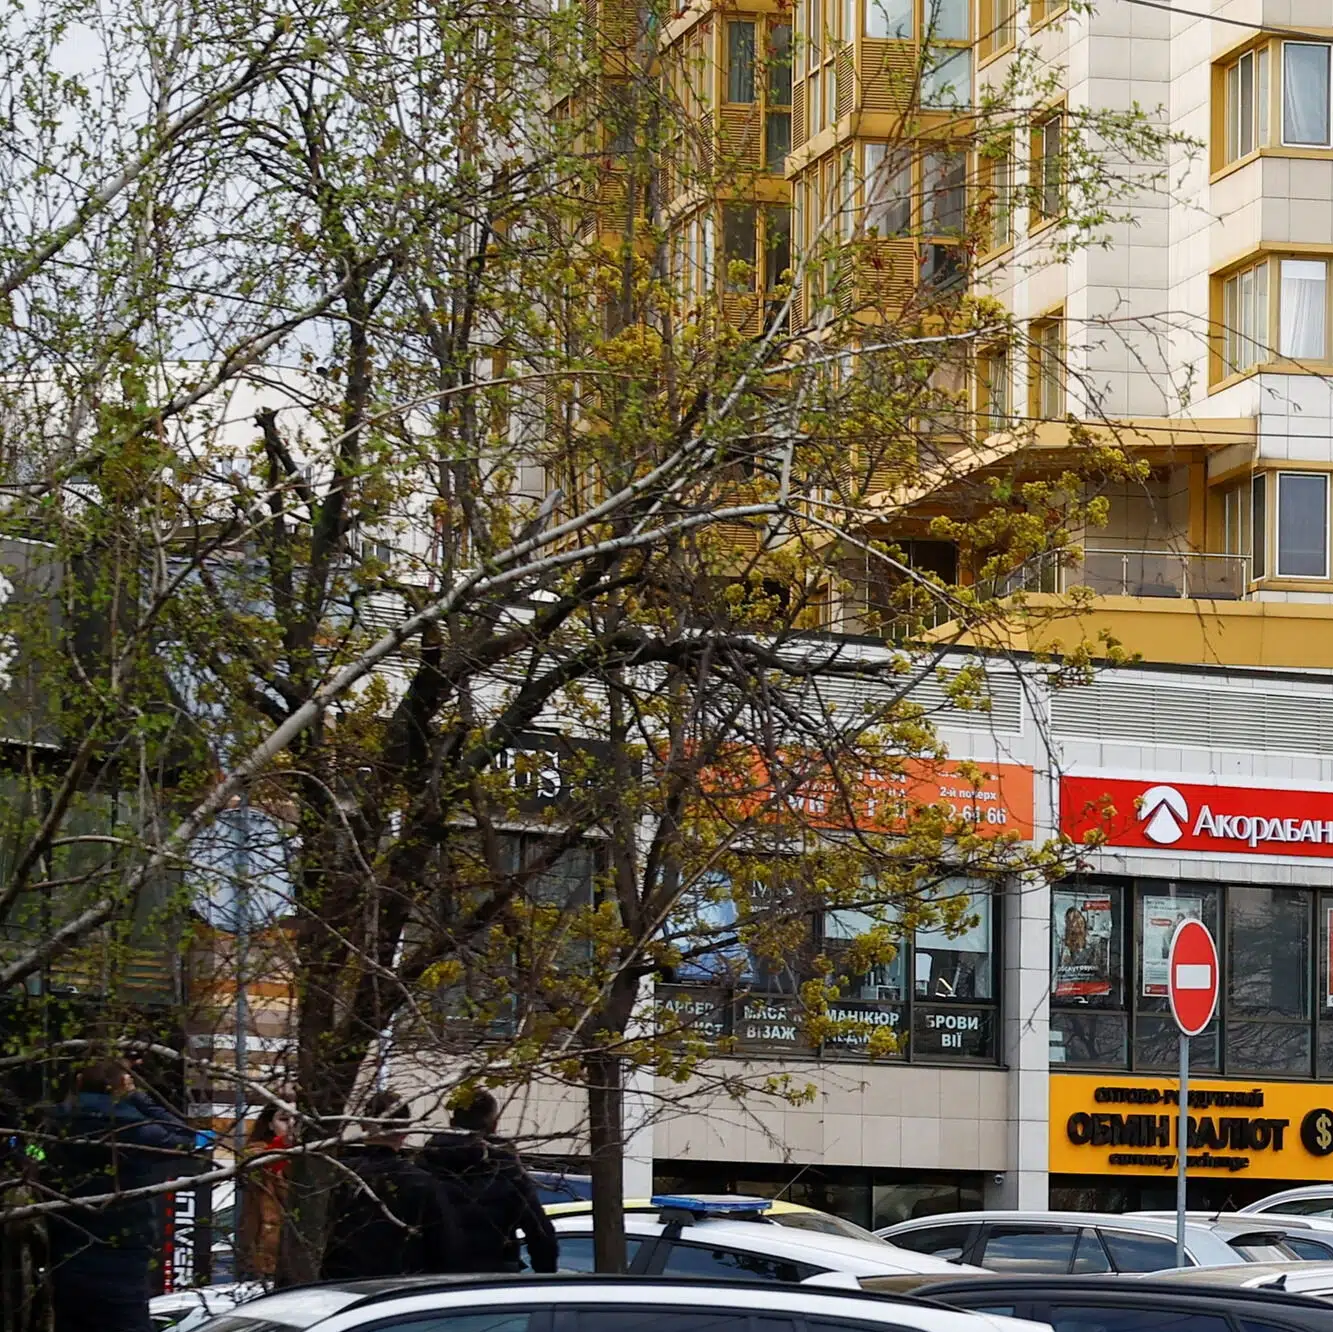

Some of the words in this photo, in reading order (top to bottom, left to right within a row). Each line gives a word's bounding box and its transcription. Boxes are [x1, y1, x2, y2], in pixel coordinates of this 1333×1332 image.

[824, 1009, 900, 1027] МАНІКЮР
[925, 1014, 979, 1030] БРОВИ
[746, 1024, 797, 1041] ВІЗАЖ
[941, 1031, 963, 1048] ВІЇ
[1067, 1112, 1170, 1148] ОБМІН
